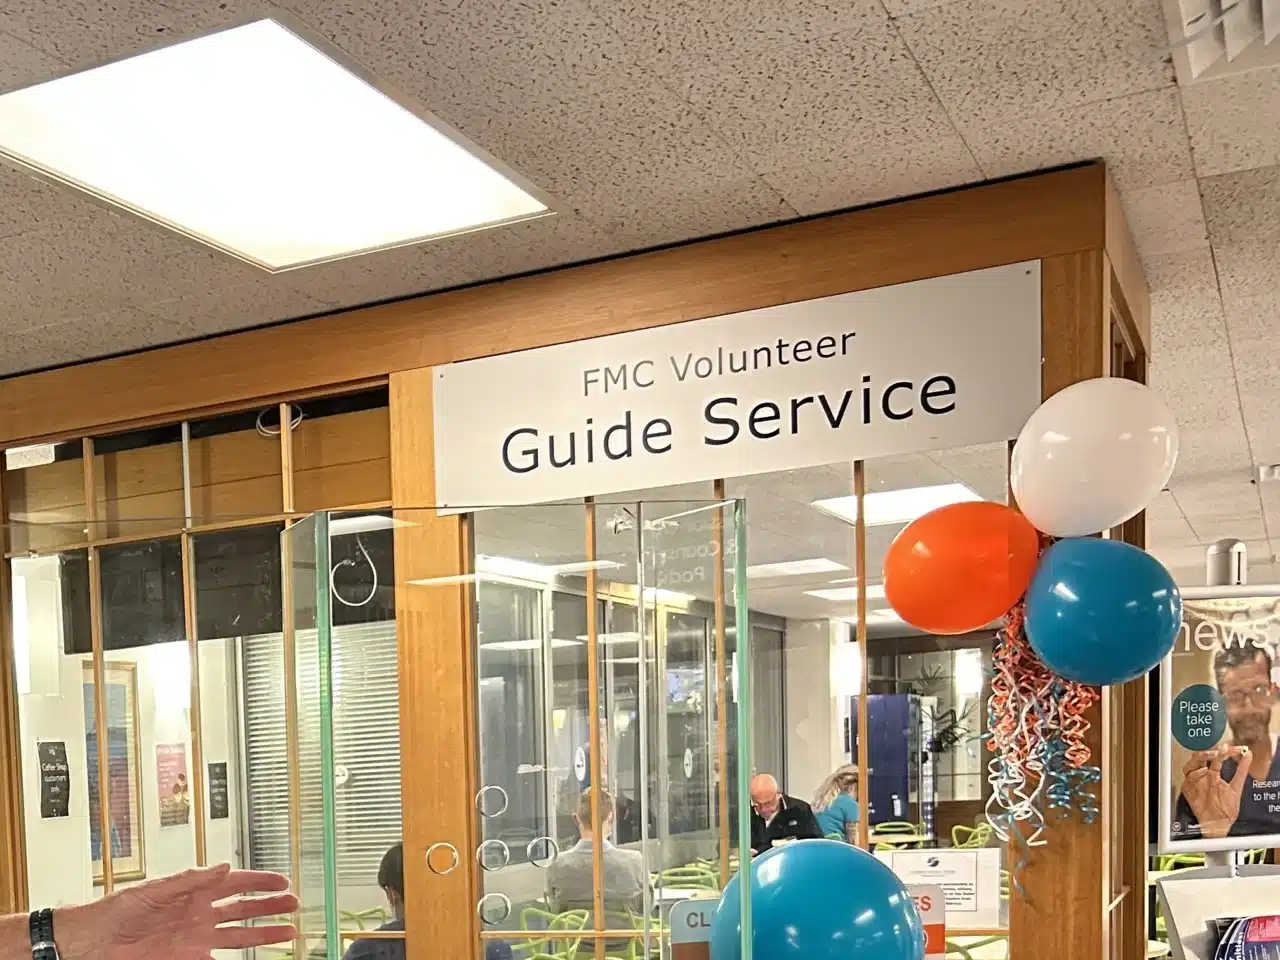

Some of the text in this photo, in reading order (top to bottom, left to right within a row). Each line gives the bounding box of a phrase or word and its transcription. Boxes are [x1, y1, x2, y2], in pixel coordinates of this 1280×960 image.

[583, 331, 856, 397] FMC Volunteer
[501, 373, 958, 474] Guide Service
[1181, 620, 1269, 651] news
[1180, 700, 1220, 713] Please
[1186, 713, 1212, 725] take
[1188, 726, 1211, 738] one
[1253, 791, 1276, 801] to the
